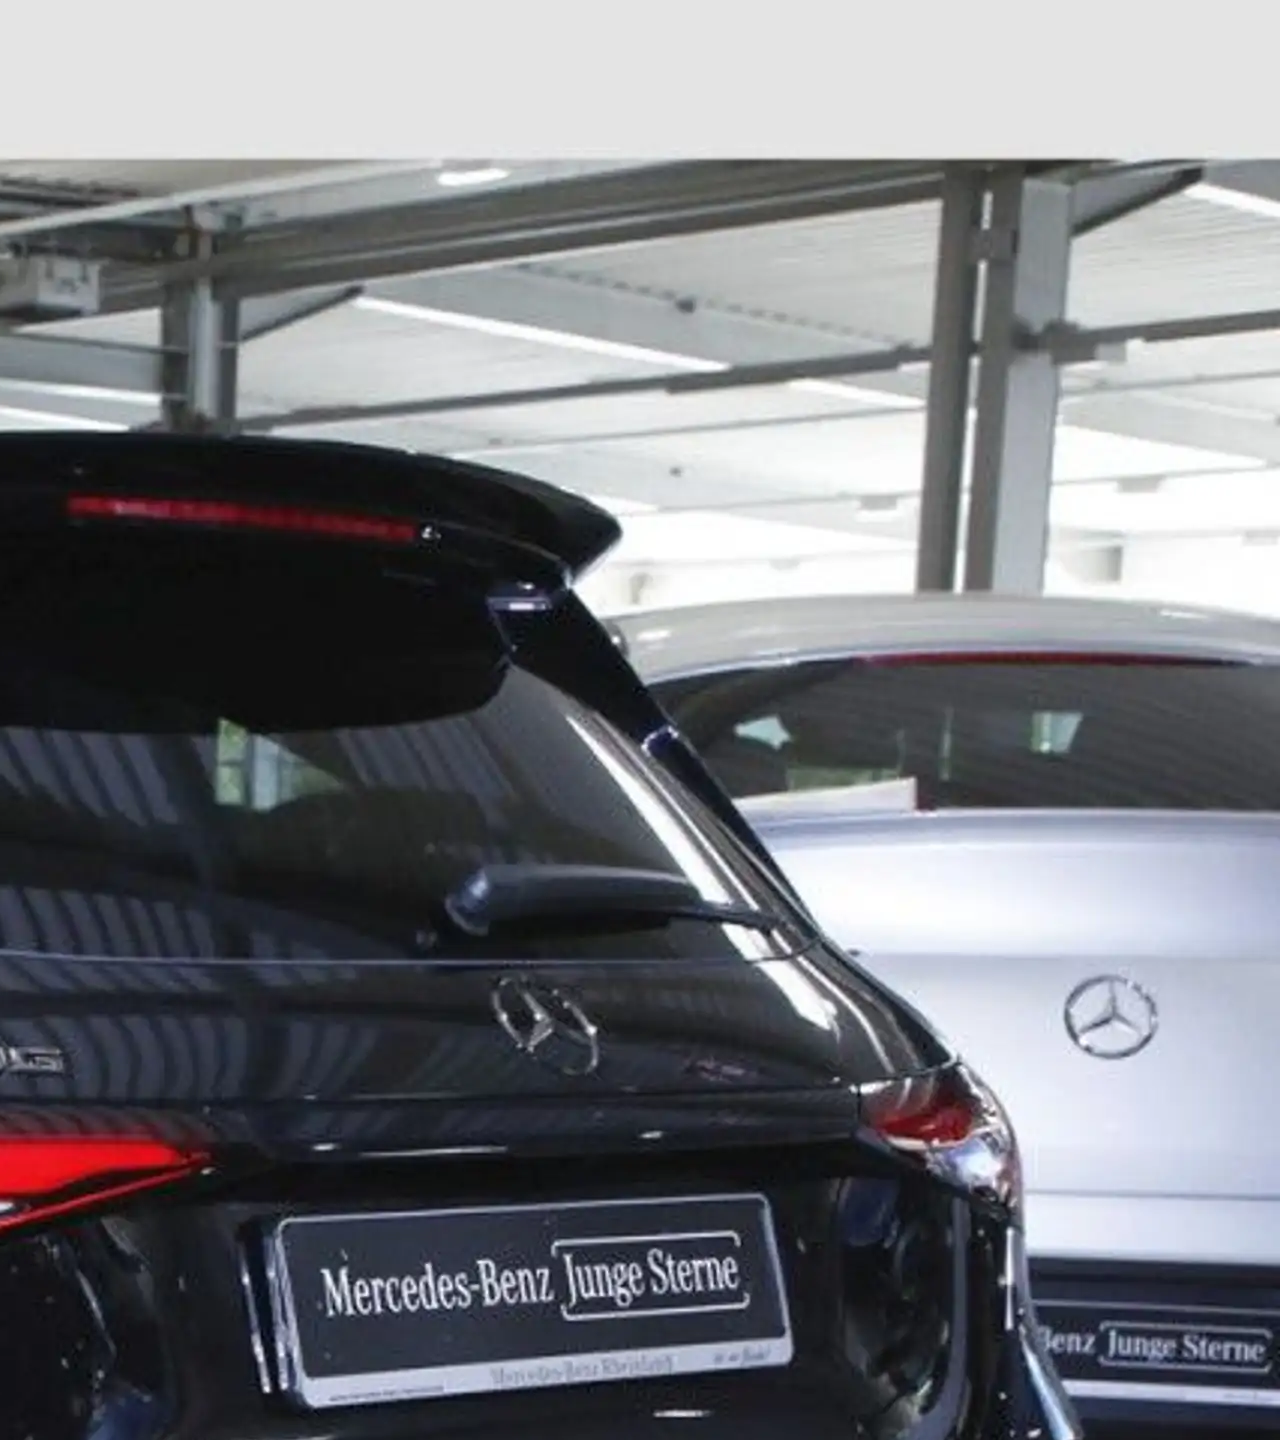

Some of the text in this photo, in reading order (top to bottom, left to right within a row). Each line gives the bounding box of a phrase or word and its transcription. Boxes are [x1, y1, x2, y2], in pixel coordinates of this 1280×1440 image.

[320, 1248, 739, 1317] Mercedes-Benz Junge Sterne
[1109, 1328, 1177, 1358] Junge
[1183, 1332, 1265, 1362] Sterne
